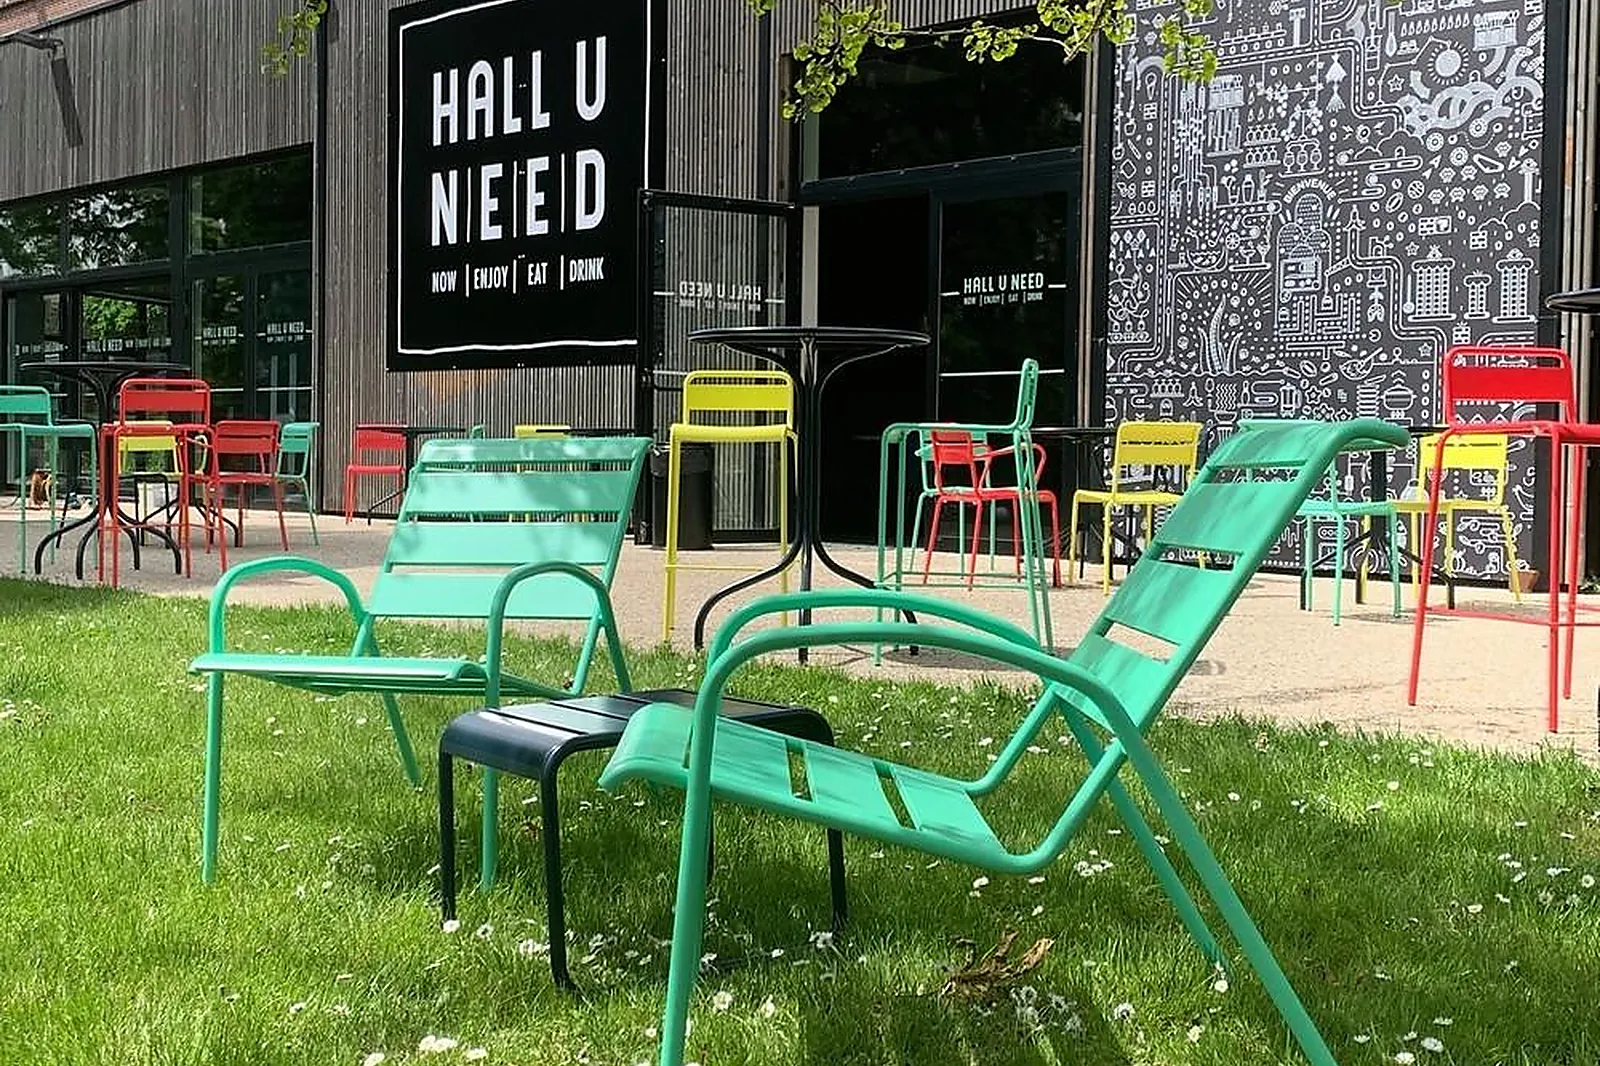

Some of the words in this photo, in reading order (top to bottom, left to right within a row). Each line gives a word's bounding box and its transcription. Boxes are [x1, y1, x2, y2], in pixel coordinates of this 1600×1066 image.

[433, 50, 551, 147] HALL
[576, 36, 607, 121] U
[1283, 178, 1337, 203] BIENVENUE
[432, 270, 457, 293] NOW
[473, 265, 509, 290] ENJOY
[527, 262, 548, 286] EAT
[569, 256, 604, 282] DRINK
[963, 276, 994, 294] HALL
[998, 274, 1007, 291] U
[1010, 272, 1044, 291] NEED
